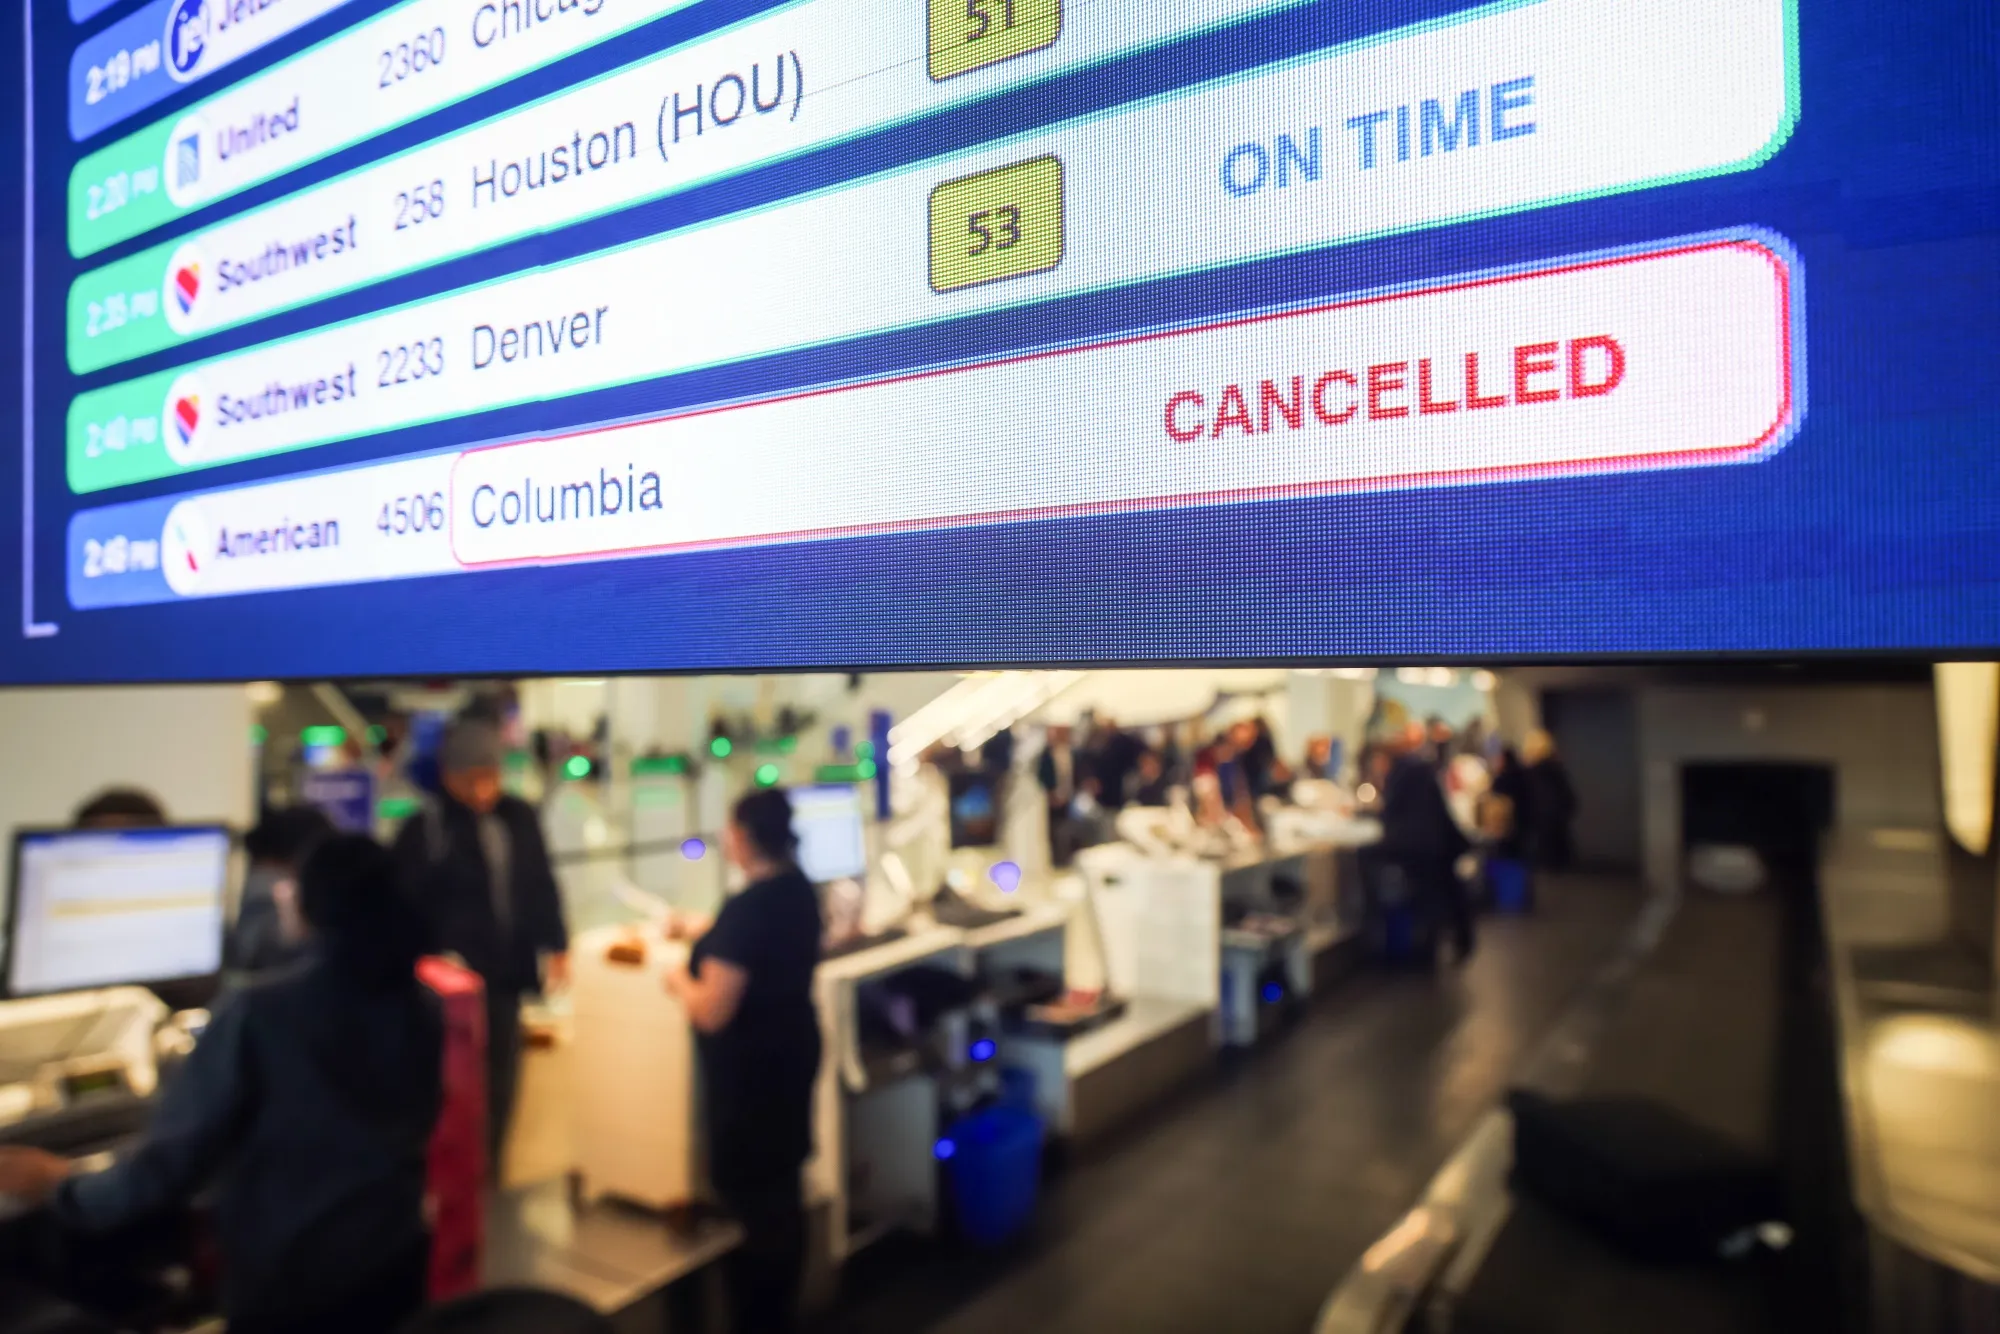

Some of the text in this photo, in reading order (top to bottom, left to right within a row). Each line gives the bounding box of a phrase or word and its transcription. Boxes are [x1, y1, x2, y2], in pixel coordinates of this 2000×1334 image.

[216, 95, 300, 161] United
[378, 25, 446, 89] 2360
[216, 214, 358, 292] Southwest
[393, 178, 446, 231] 258
[472, 118, 637, 210] Houston
[656, 48, 804, 163] (HOU)
[216, 362, 357, 428] Southwest
[376, 336, 445, 389] 2233
[472, 304, 609, 370] Denver
[967, 203, 1020, 256] 53
[1219, 124, 1323, 201] ON
[1346, 73, 1538, 172] TIME
[215, 515, 341, 560] American
[375, 491, 445, 537] 4506
[471, 462, 664, 529] Columbia
[1164, 332, 1629, 444] CANCELLED
